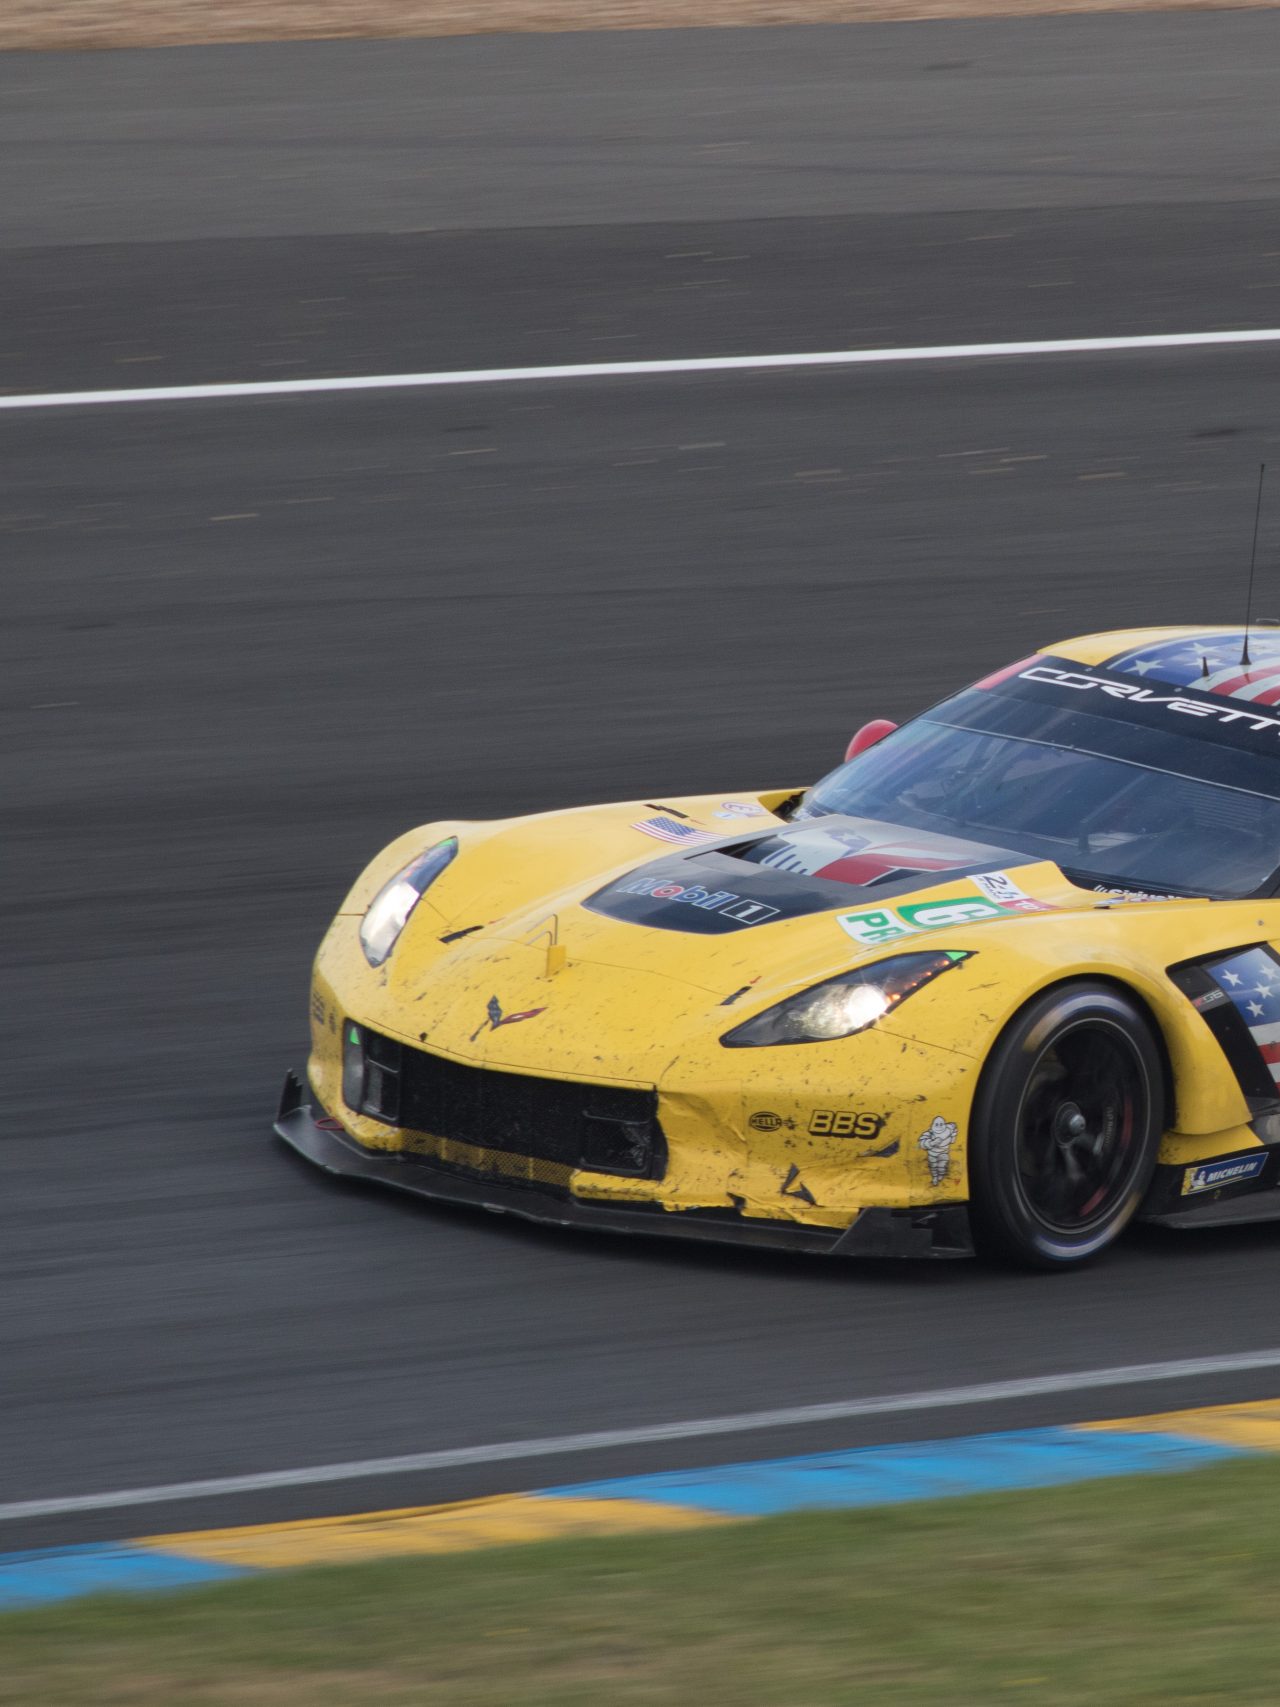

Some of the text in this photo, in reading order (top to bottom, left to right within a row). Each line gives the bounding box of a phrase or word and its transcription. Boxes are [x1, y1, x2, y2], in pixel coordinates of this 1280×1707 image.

[617, 878, 739, 910] Mobil
[808, 1109, 882, 1139] BBS
[1206, 1161, 1258, 1183] MICHELIN
